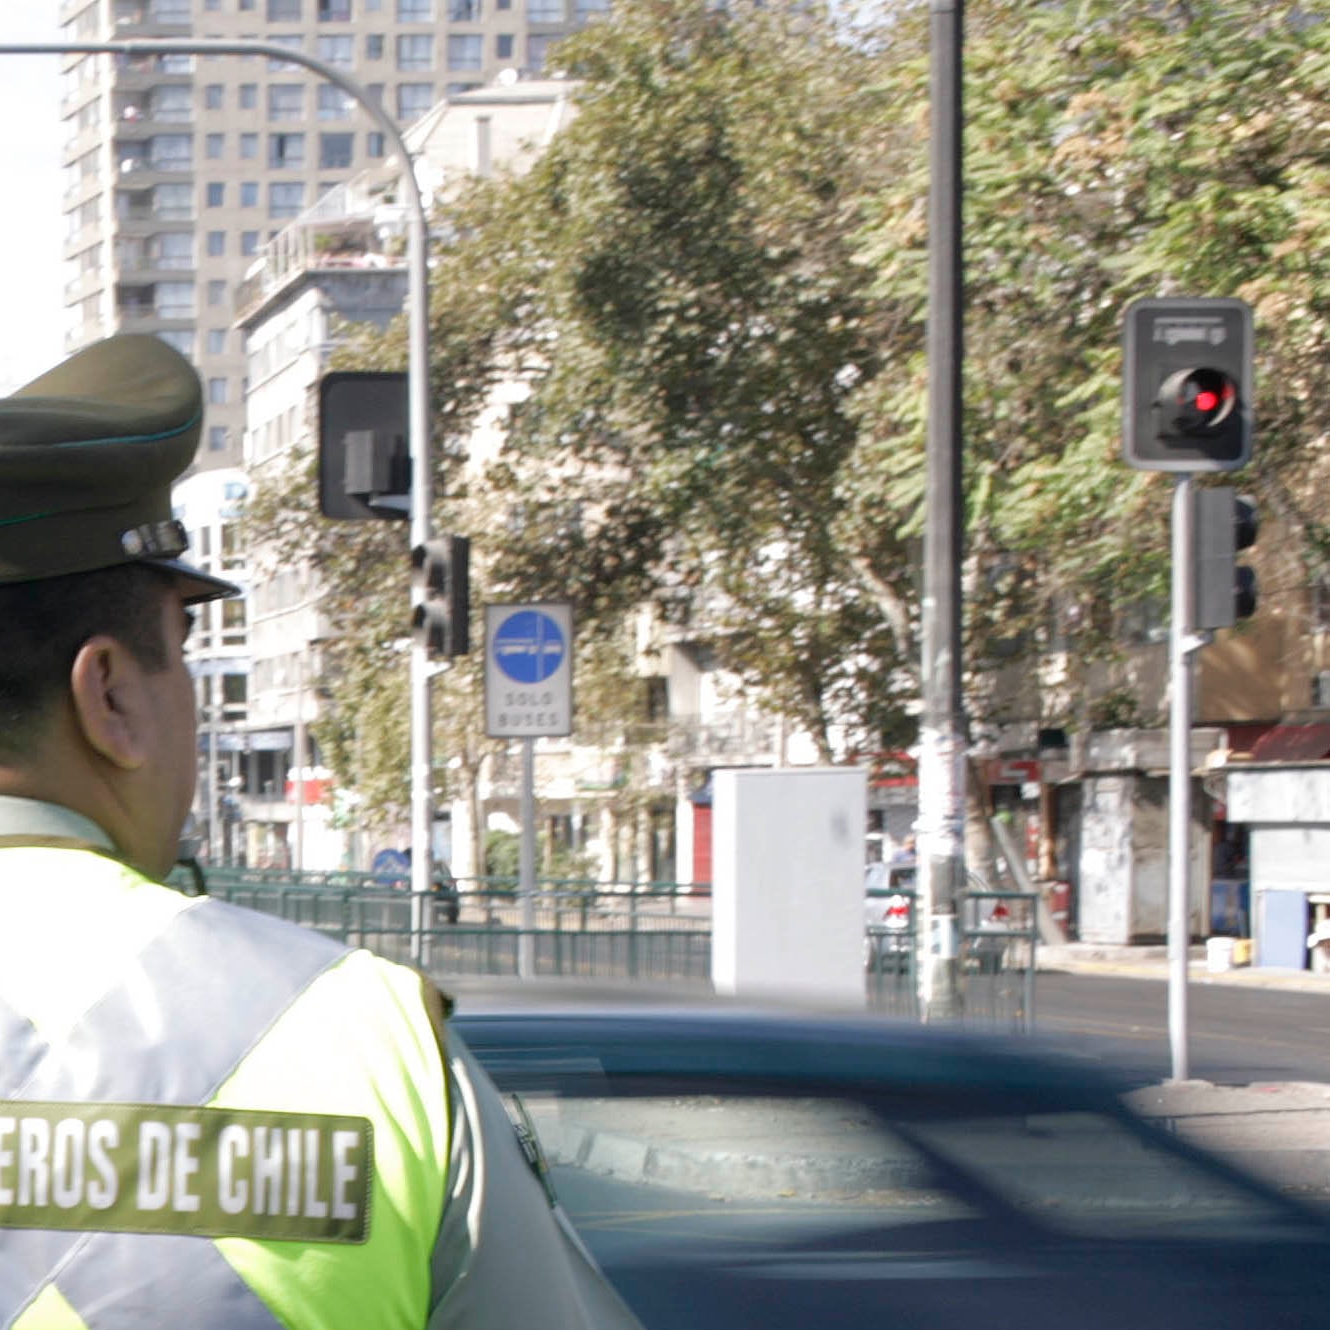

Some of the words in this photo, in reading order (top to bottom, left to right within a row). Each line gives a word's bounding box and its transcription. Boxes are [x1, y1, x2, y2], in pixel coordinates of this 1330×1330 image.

[505, 691, 553, 707] SOLO
[498, 713, 559, 727] BUSES
[137, 1119, 200, 1212] DE
[217, 1124, 360, 1219] CHILE
